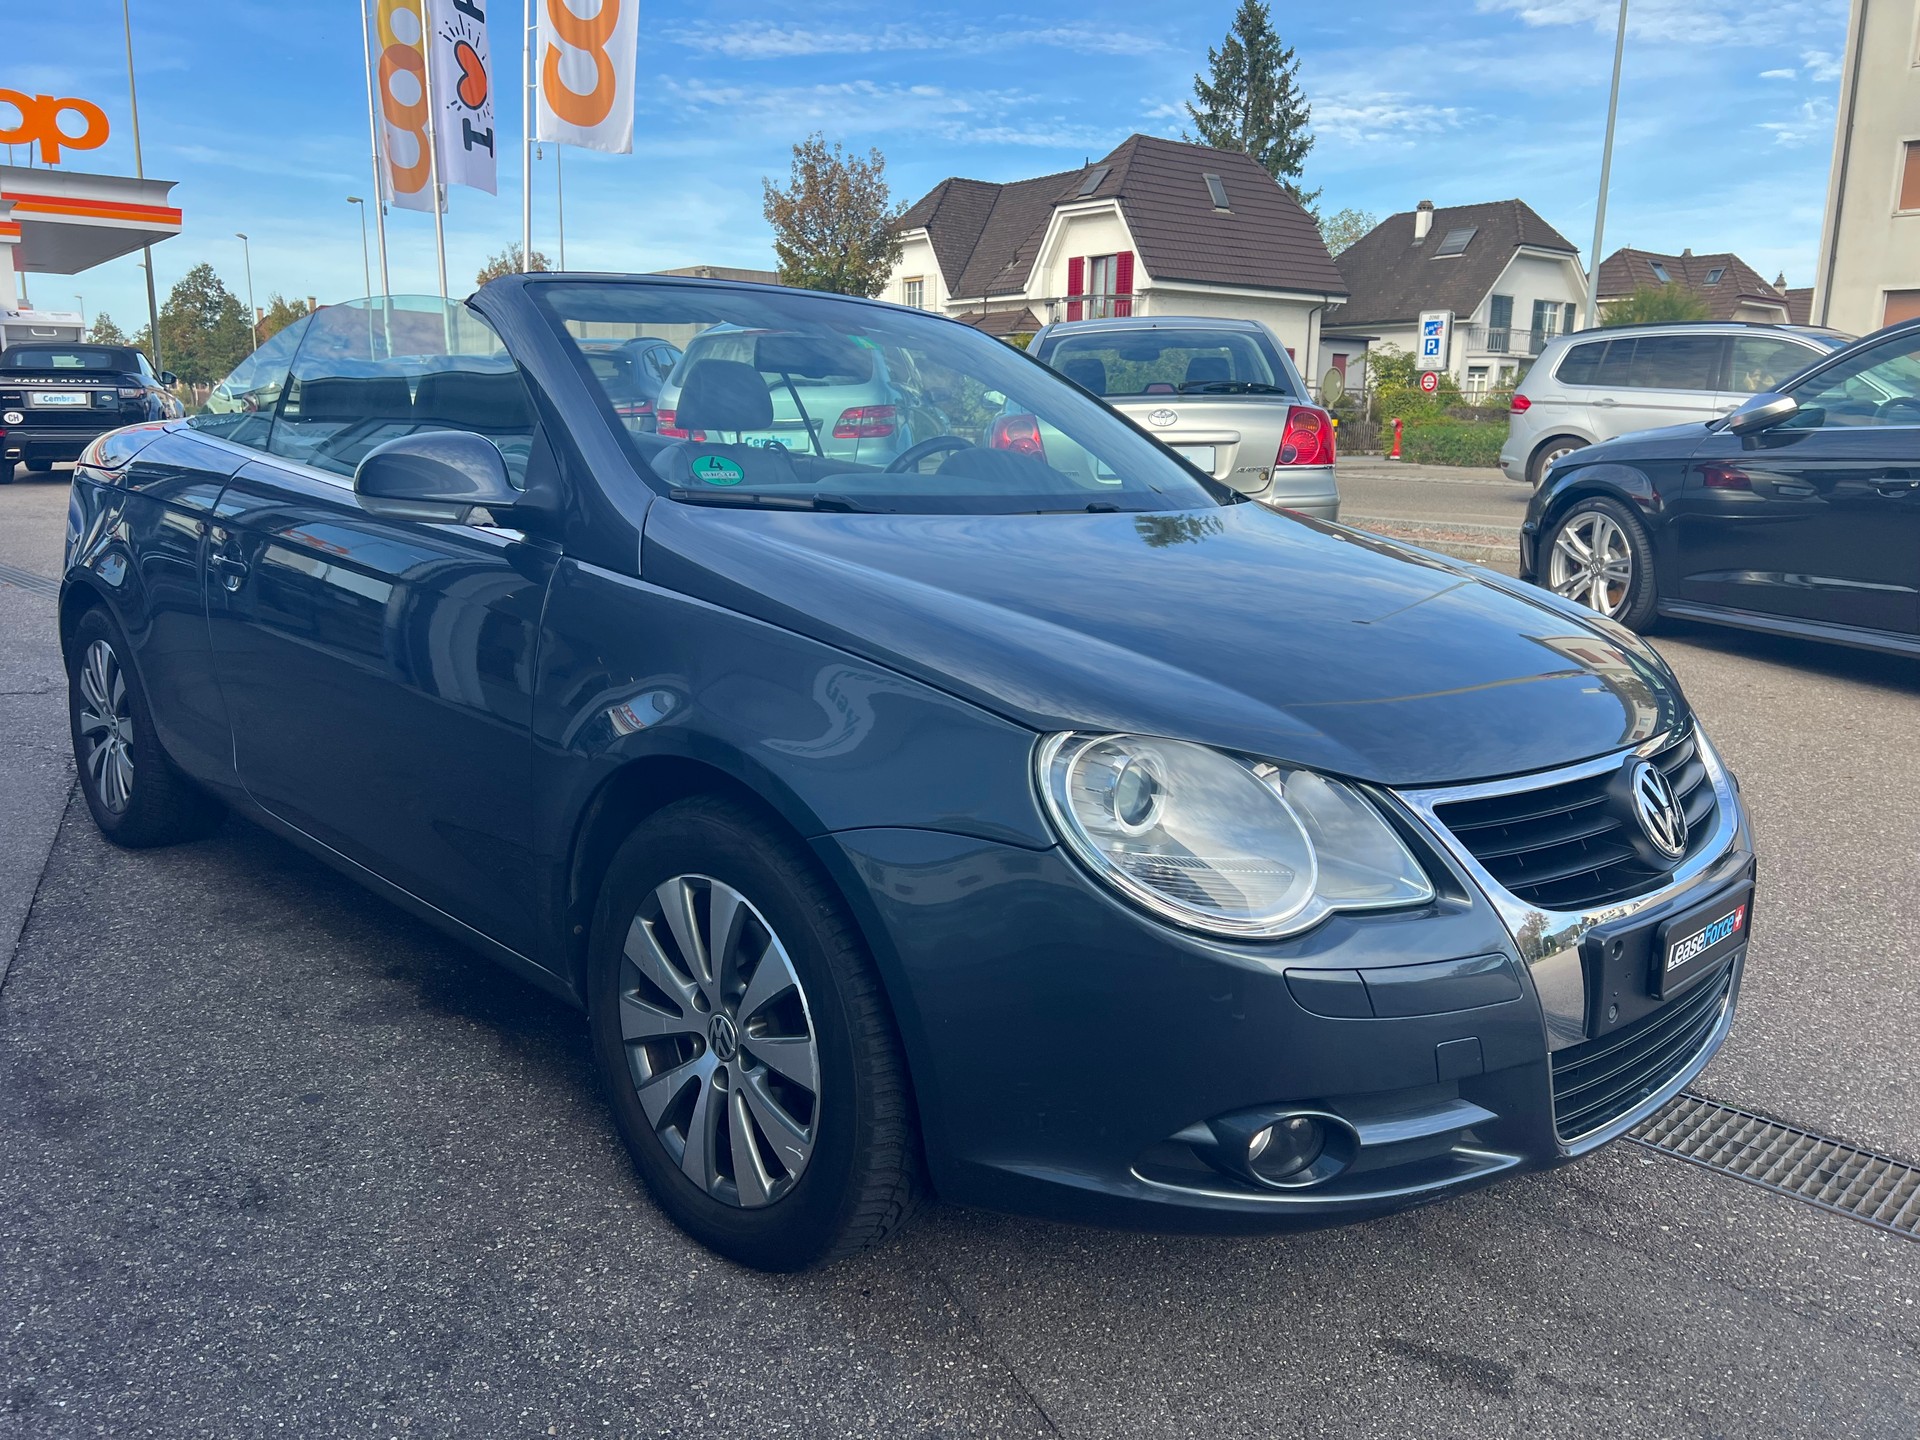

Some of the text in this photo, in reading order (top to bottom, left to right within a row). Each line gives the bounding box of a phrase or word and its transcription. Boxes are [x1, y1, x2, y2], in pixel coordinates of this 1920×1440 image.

[462, 117, 494, 159] I
[8, 414, 20, 422] CH
[709, 456, 724, 471] 4
[1667, 914, 1735, 969] LeaseForce
